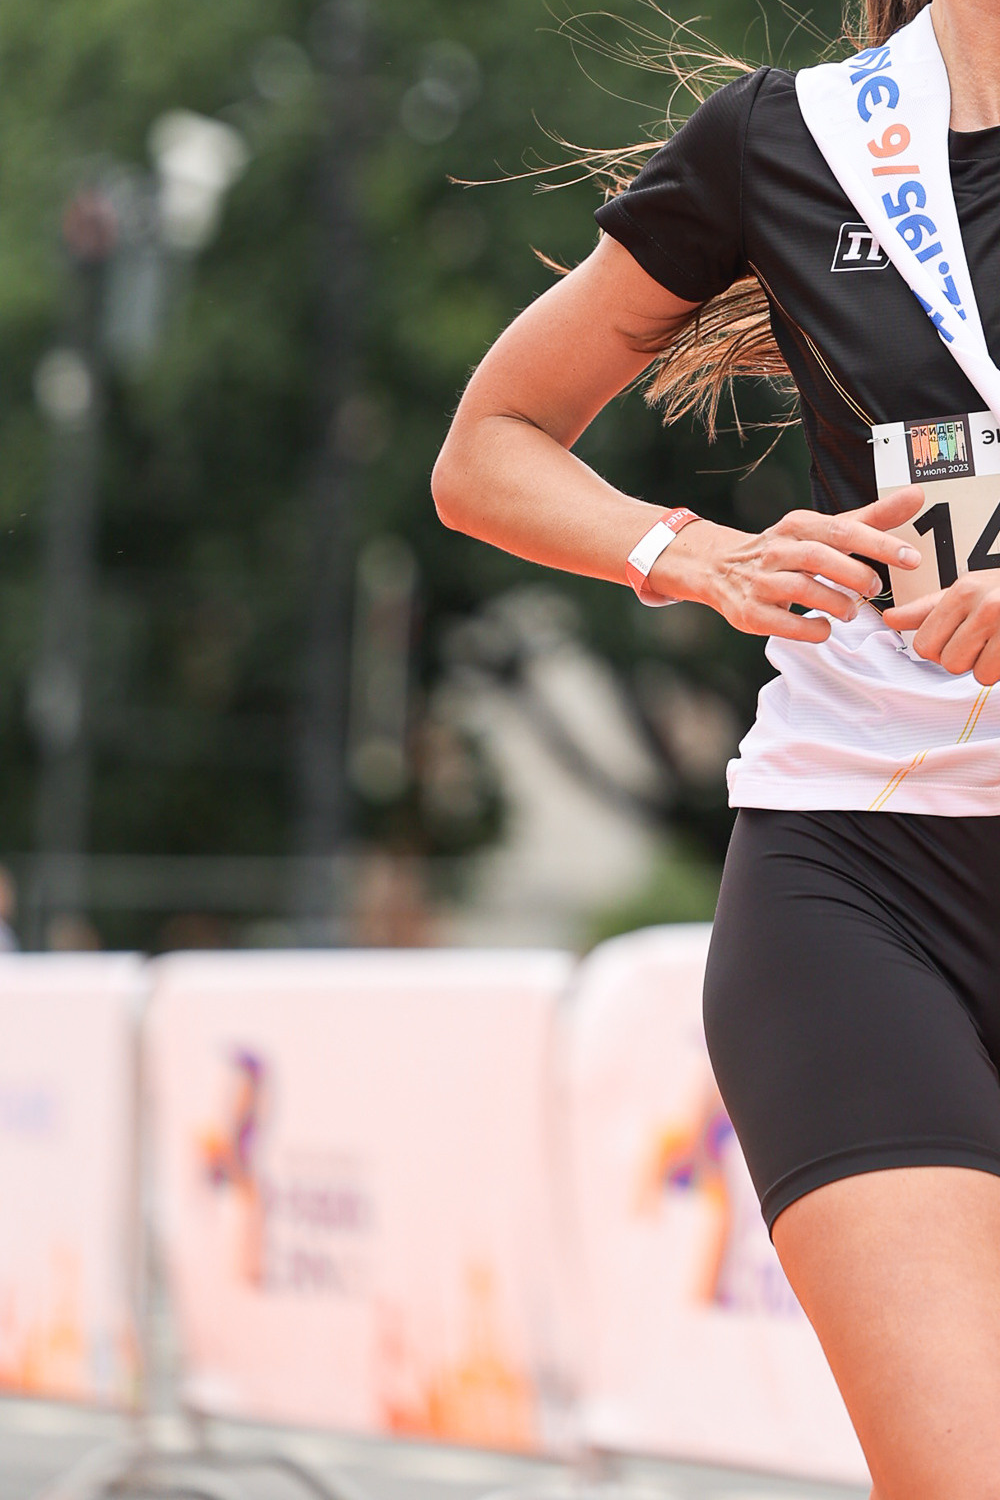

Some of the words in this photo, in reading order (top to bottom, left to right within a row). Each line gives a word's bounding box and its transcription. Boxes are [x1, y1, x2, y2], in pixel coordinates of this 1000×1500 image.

[911, 424, 963, 437] ЭКИДЕН
[915, 469, 921, 477] 9
[923, 467, 946, 476] июля
[948, 463, 969, 473] 2023
